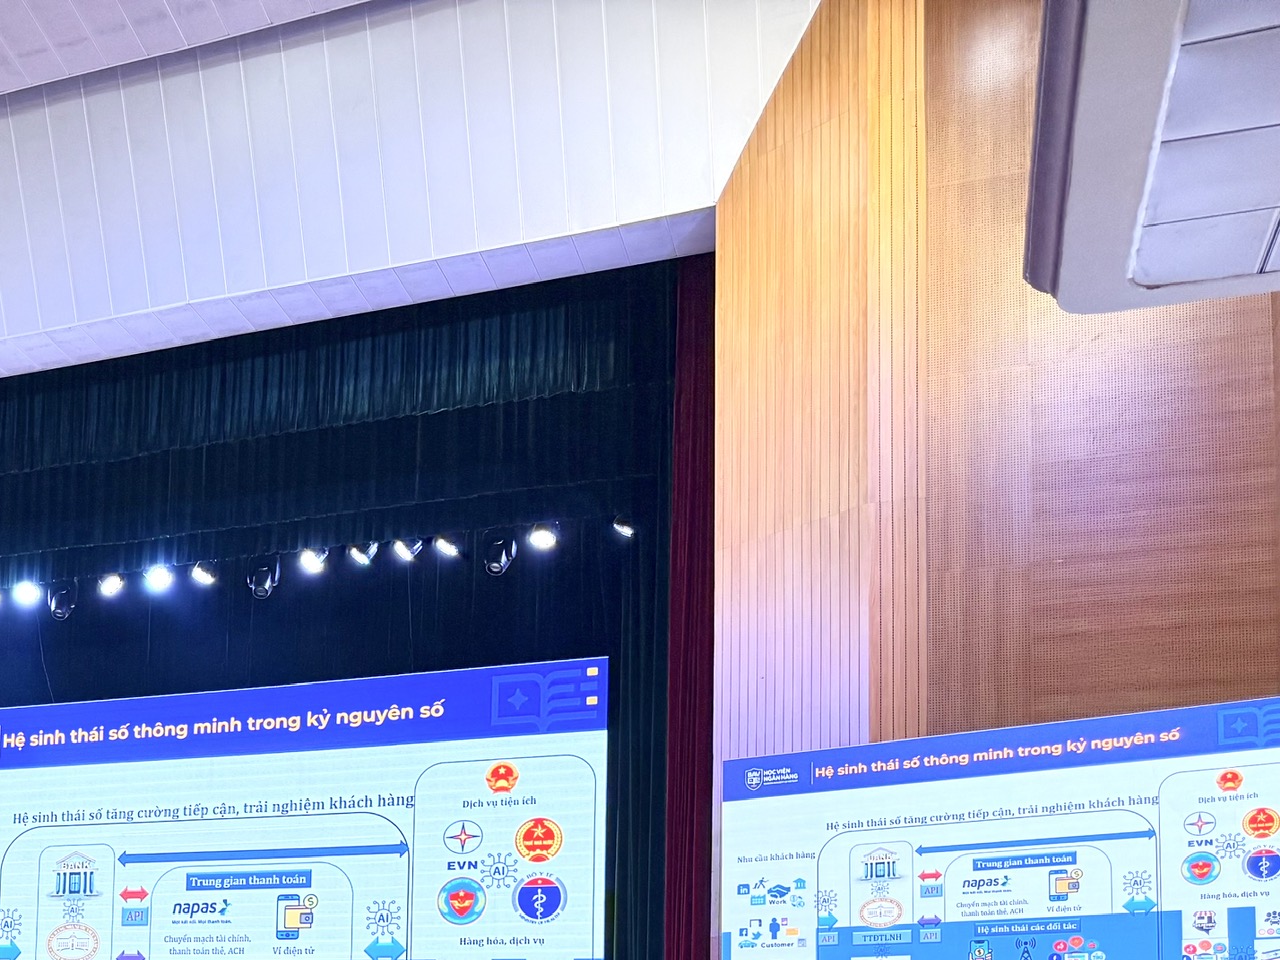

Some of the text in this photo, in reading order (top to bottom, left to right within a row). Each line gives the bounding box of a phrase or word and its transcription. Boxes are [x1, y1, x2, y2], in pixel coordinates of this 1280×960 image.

[3, 699, 446, 750] Hệ sinh thái số thông minh trong kỷ nguyên số
[816, 727, 1180, 778] Hệ sinh thái số thông minh trong kỷ nguyên số
[463, 797, 537, 809] Dịch vụ tiện ích
[13, 793, 415, 826] Hệ sinh thái số tăng cường tiếp cận, trải nghiệm khách hàng
[827, 795, 1159, 832] Hệ sinh thái số tăng cường tiếp cận, trải nghiệm khách hàng
[1188, 839, 1213, 847] EVN
[770, 852, 794, 861] khách
[1004, 860, 1022, 868] gian
[1052, 855, 1072, 863] toán
[62, 861, 90, 869] BANK
[447, 861, 478, 870] EVN
[494, 867, 505, 875] AI
[190, 874, 306, 888] Trung gian thanh toán
[963, 878, 999, 889] napas
[173, 902, 217, 918] napas
[127, 912, 144, 921] API
[378, 914, 389, 922] AI
[460, 937, 544, 947] Hàng hóa, dịch vụ
[273, 947, 282, 955] Ví
[284, 947, 300, 956] điện
